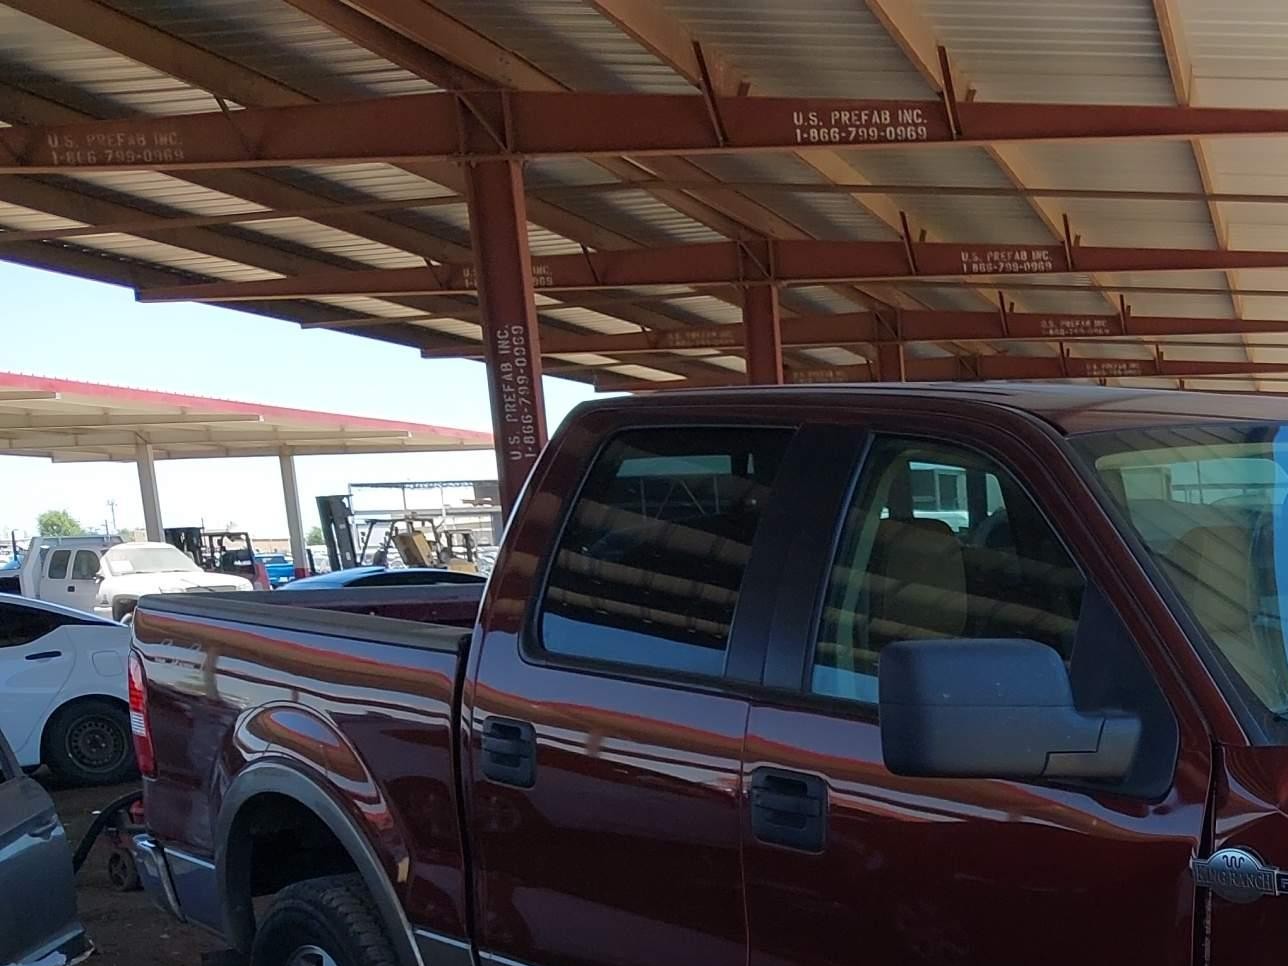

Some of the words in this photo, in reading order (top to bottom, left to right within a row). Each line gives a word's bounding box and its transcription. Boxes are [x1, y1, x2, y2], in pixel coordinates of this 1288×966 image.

[793, 111, 823, 126] U.S.
[831, 110, 890, 125] PREFAB
[898, 109, 927, 124] INC.
[87, 132, 146, 147] PREFAB
[795, 126, 927, 143] 1-866-799-0969
[987, 250, 1028, 262] PREFAB
[497, 325, 510, 354] INC.
[500, 362, 518, 422] PREFAB
[1229, 869, 1273, 891] RANCH
